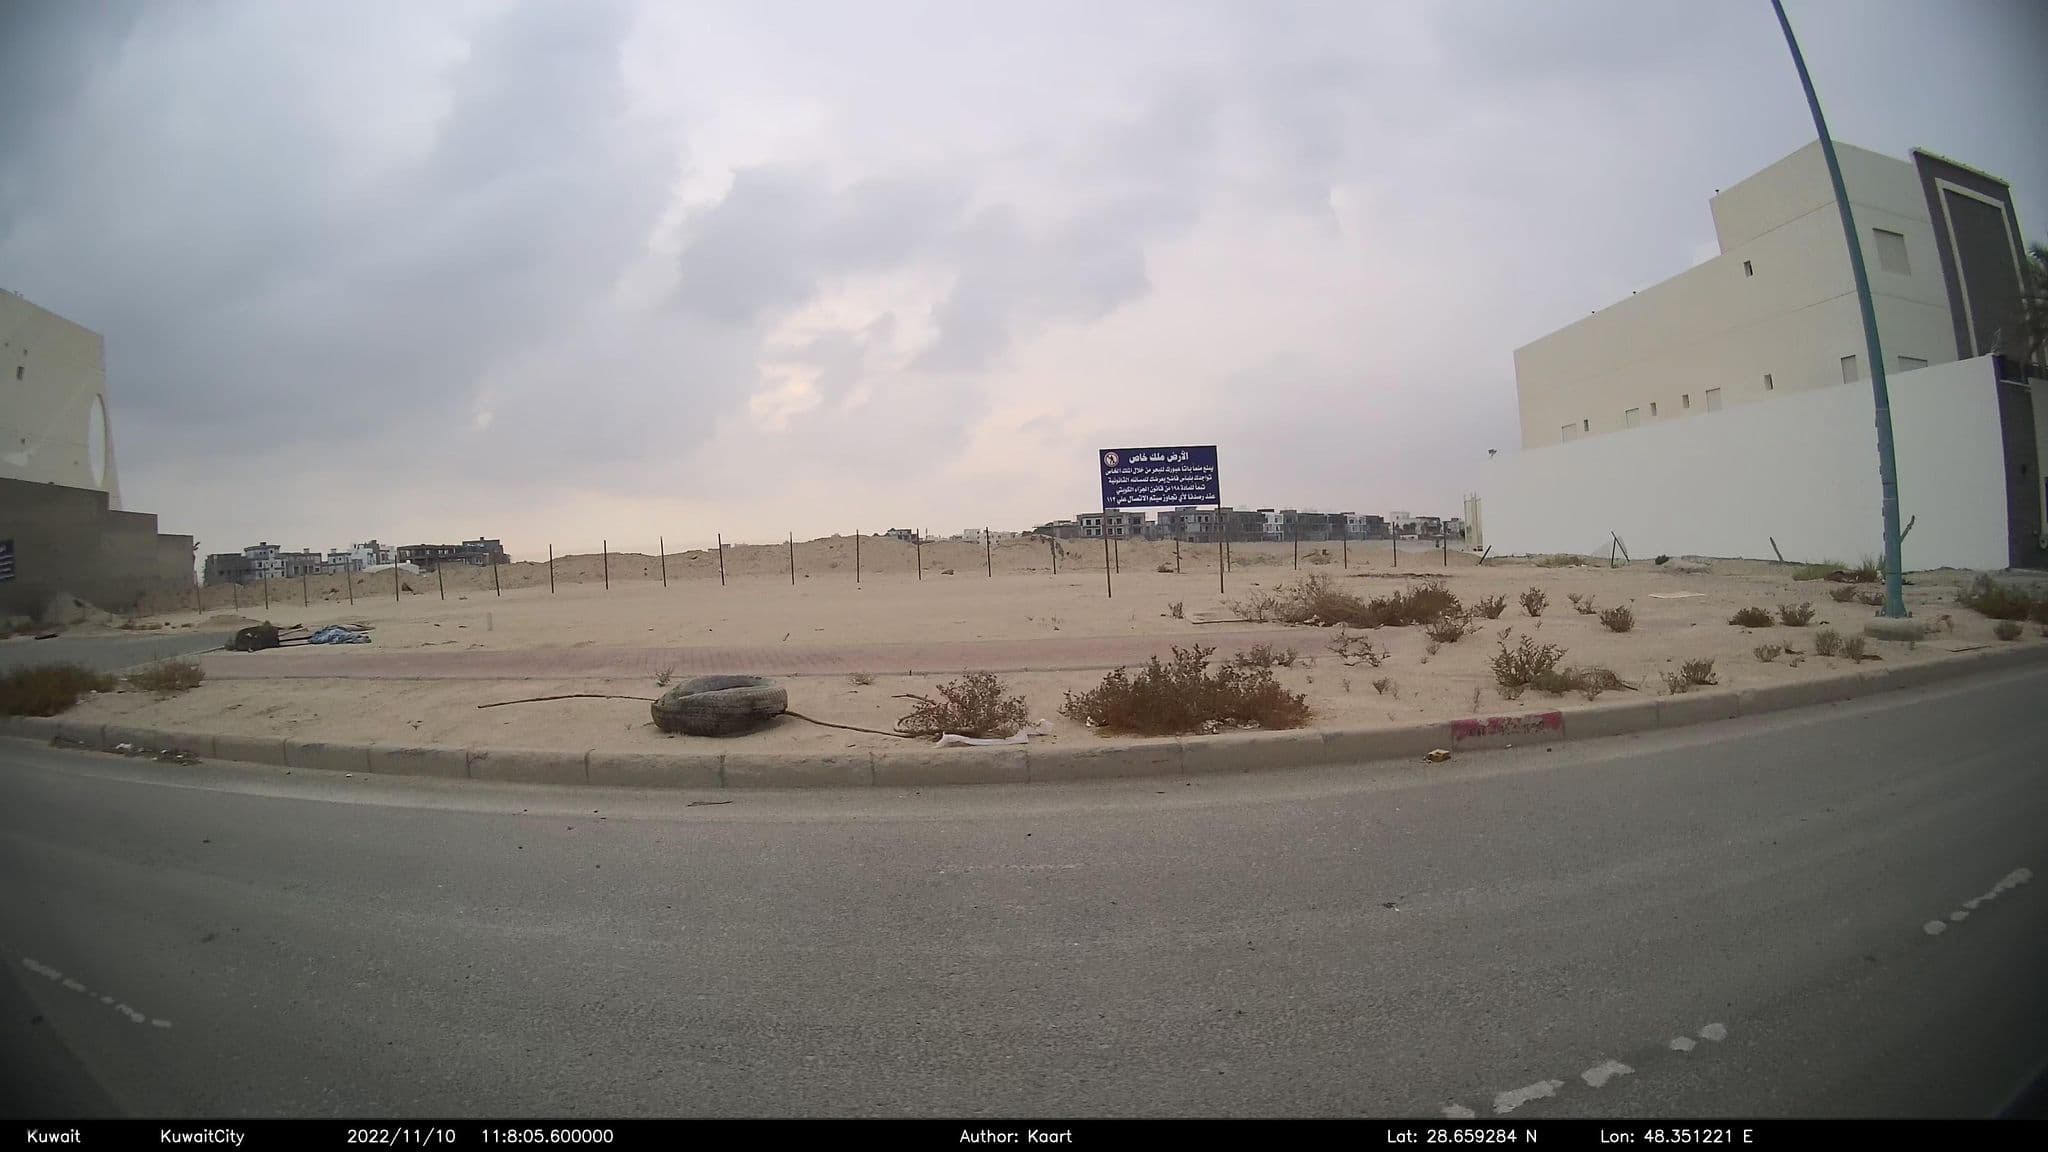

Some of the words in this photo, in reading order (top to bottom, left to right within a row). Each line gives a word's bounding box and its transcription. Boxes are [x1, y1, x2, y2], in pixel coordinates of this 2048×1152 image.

[1129, 452, 1148, 464] خاص
[1150, 453, 1164, 462] ملك
[1167, 450, 1188, 462] الأرض
[1162, 494, 1178, 502] تجاوز
